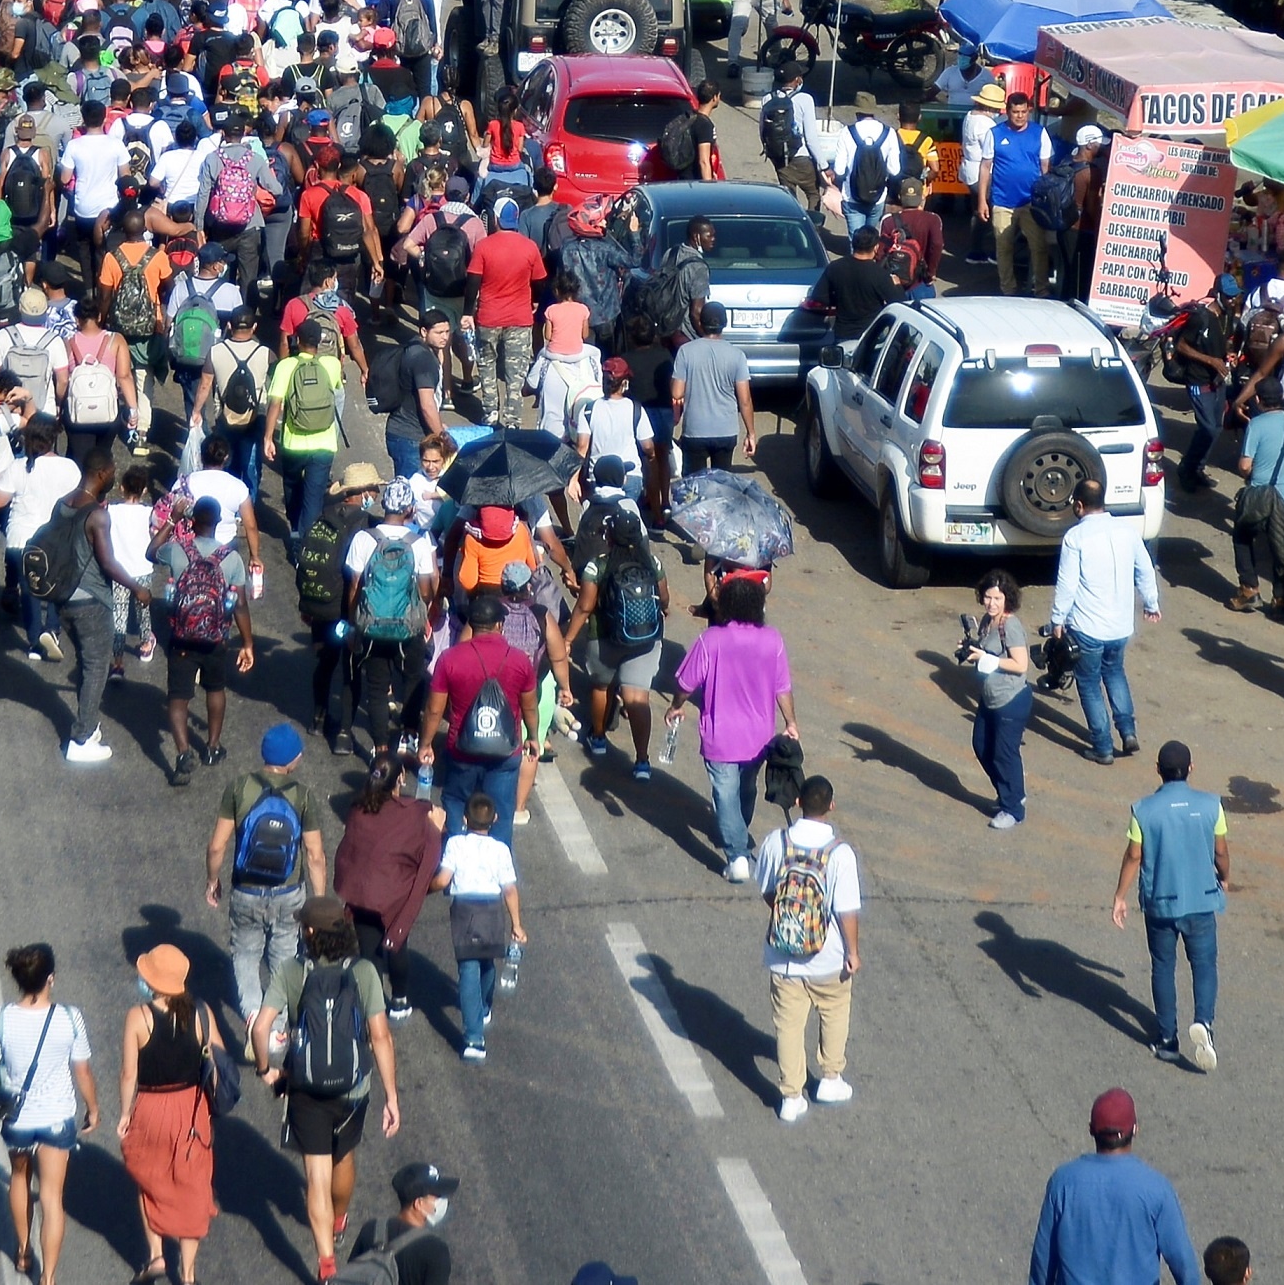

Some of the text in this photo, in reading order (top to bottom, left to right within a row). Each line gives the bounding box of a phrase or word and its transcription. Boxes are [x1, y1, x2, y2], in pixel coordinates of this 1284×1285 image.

[1140, 93, 1206, 125] TACOS
[1211, 93, 1236, 124] DE
[1117, 153, 1147, 165] Canasta
[1168, 146, 1179, 157] LES
[1180, 148, 1202, 160] OFRECE
[1181, 162, 1207, 175] SURTIDO
[1175, 191, 1224, 211] PRENSADO
[1162, 210, 1186, 226] PIBIL
[1102, 242, 1162, 263] -CHICHARRÓ
[1127, 266, 1146, 280] CON
[953, 482, 977, 491] Jeep
